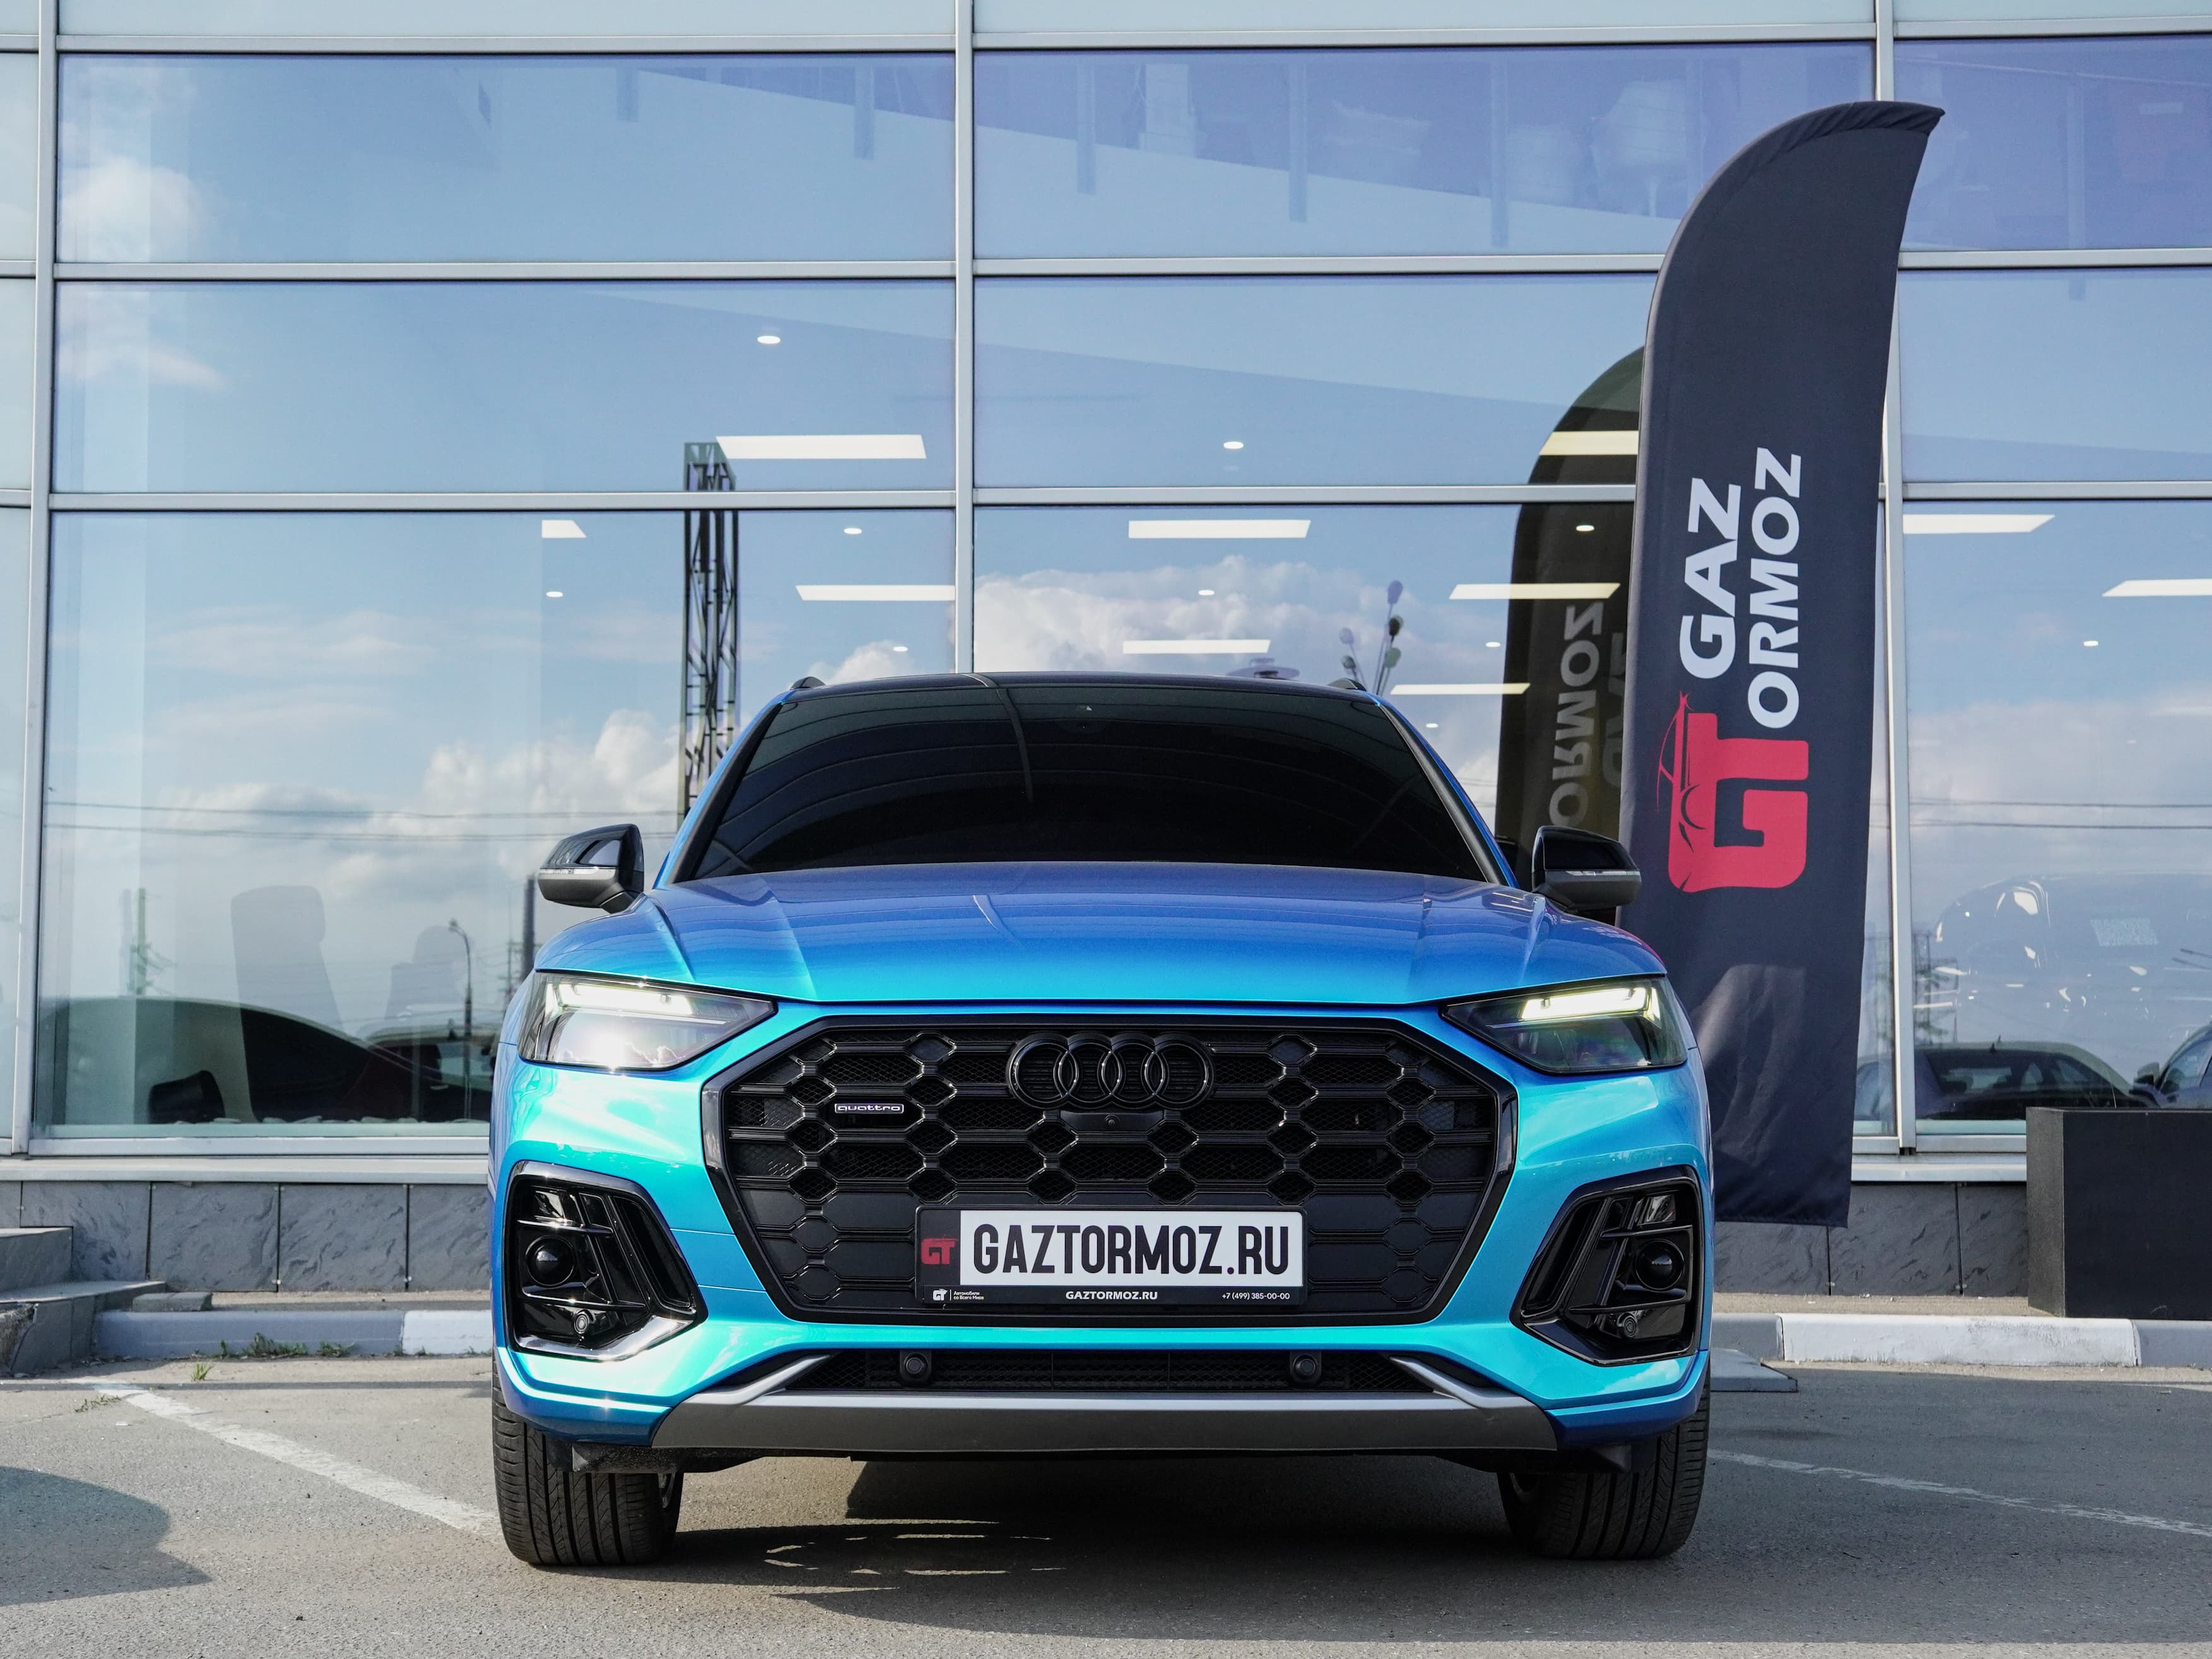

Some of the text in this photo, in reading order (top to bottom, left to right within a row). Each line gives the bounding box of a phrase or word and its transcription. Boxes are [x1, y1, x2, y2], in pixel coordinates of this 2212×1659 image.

[1679, 478, 1742, 679] GAZ
[1747, 447, 1802, 729] ORMOZ
[1667, 712, 1809, 893] GT
[921, 1238, 956, 1265] GT
[973, 1224, 1290, 1274] GAZTORMOZ.RU
[932, 1289, 948, 1301] GT
[1065, 1291, 1158, 1300] GAZTORMOZ.RU
[1232, 1292, 1250, 1300] (499)
